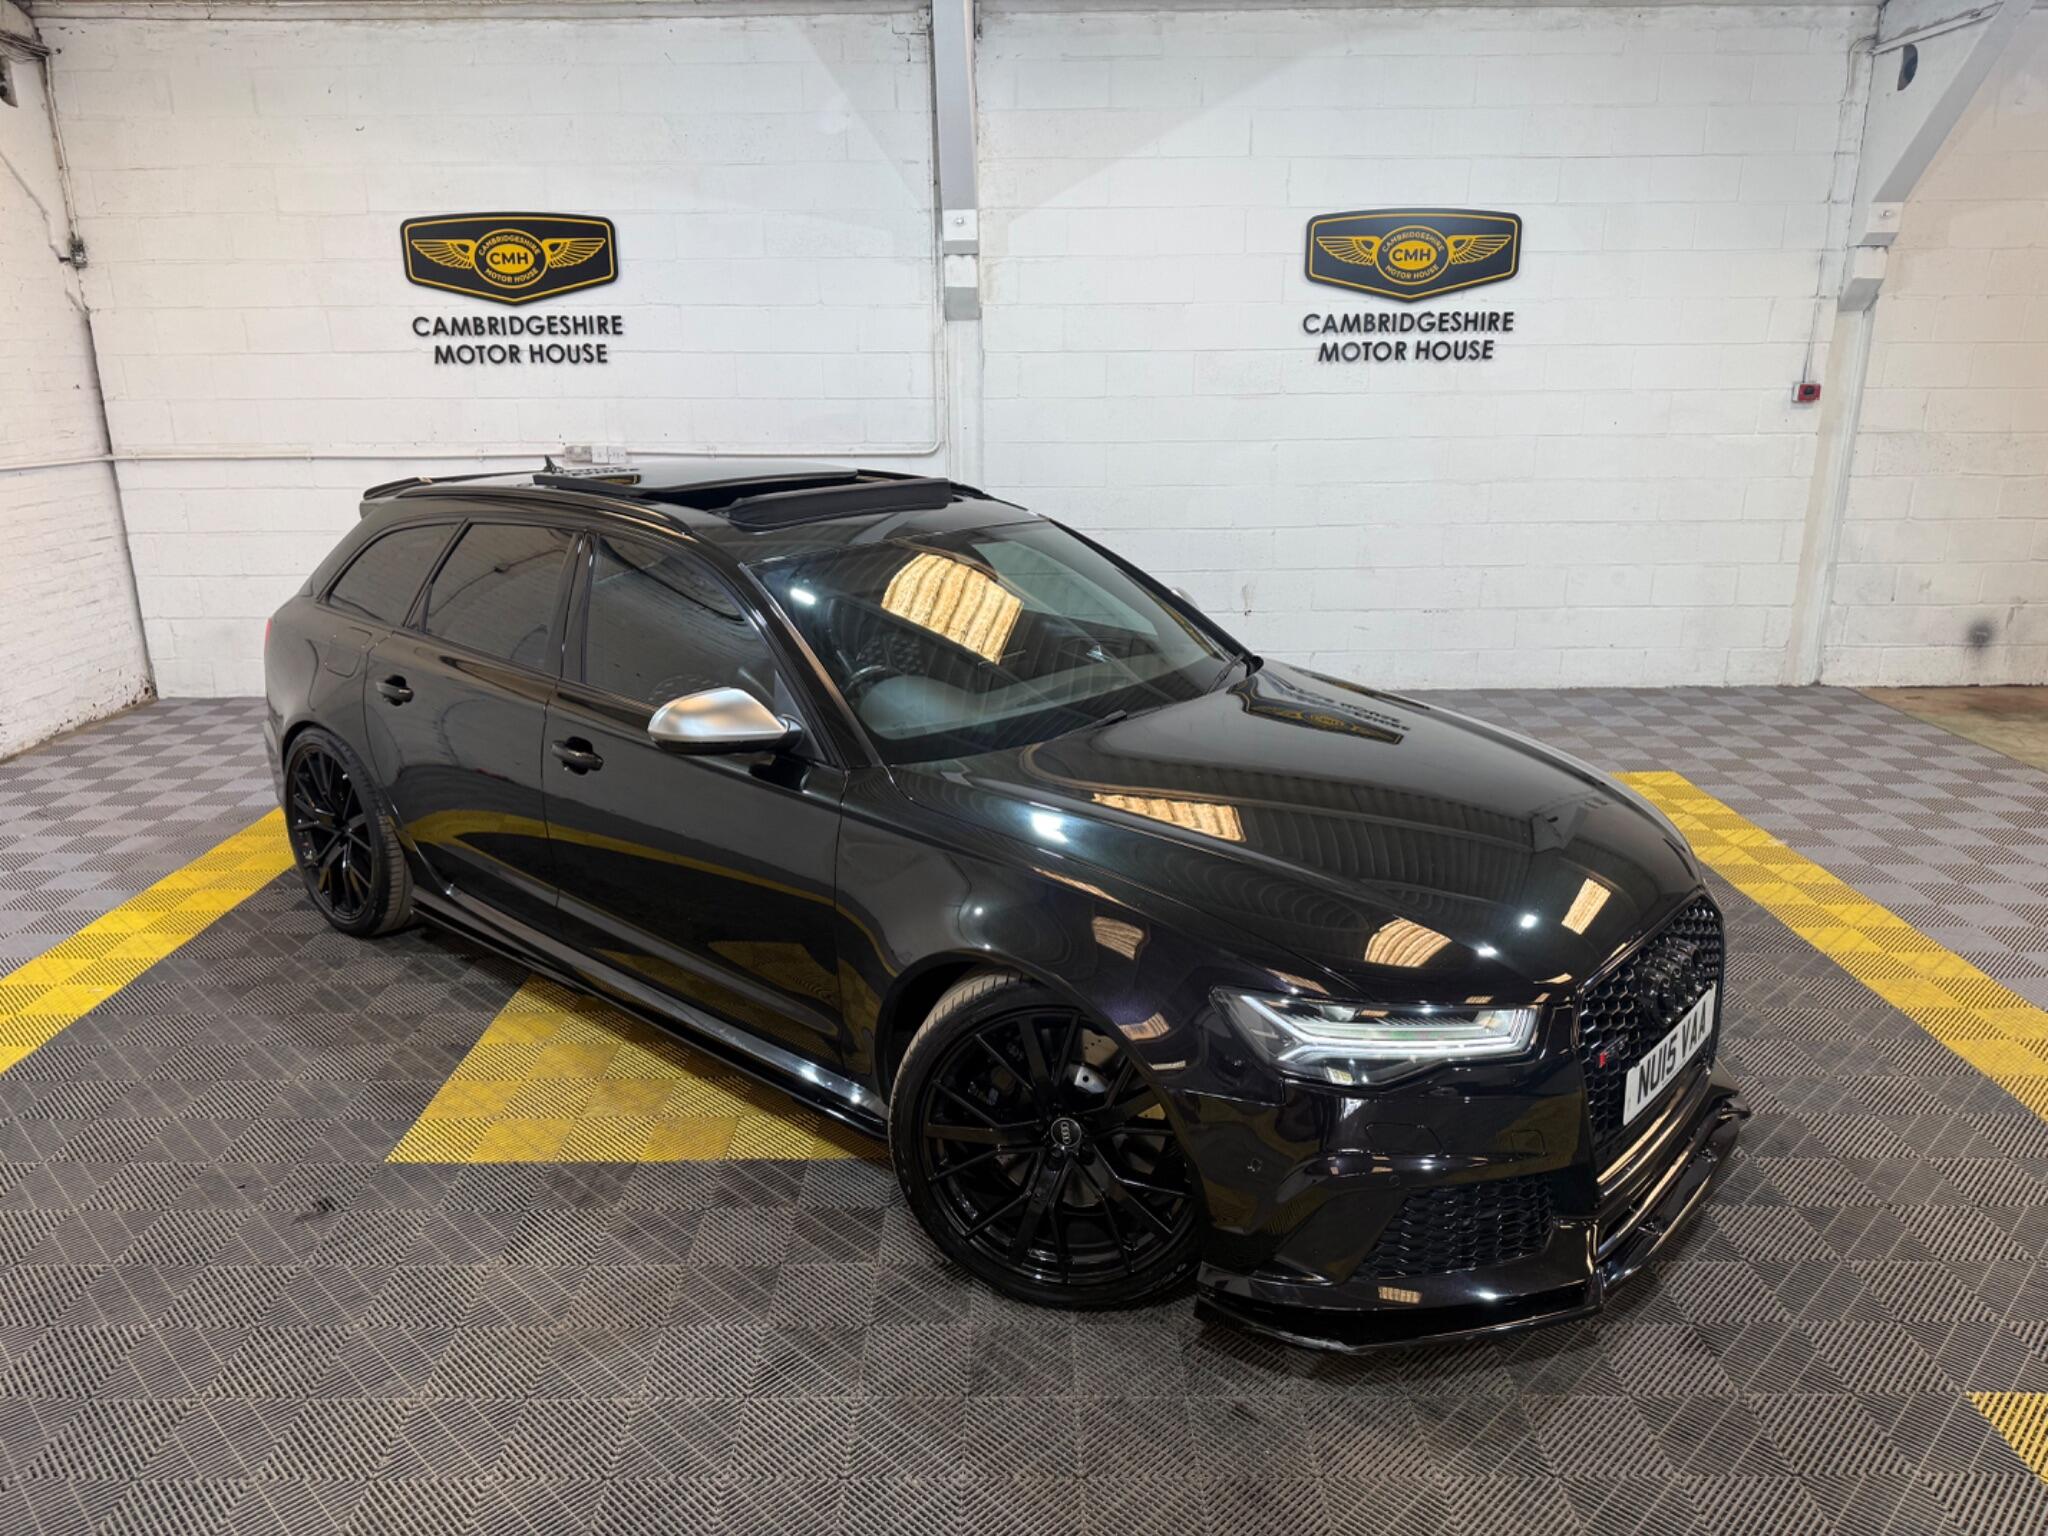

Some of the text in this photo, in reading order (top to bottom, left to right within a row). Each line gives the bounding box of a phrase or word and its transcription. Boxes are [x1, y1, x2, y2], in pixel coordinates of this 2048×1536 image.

[479, 235, 541, 256] CAMBRIDGESHIRE
[1381, 231, 1445, 253] CAMBRIDGESHIRE
[489, 252, 529, 265] CMH
[1391, 248, 1431, 262] CMH
[484, 268, 539, 283] MOTOR HOUSE
[1384, 264, 1440, 280] MOTOR HOUSE
[412, 315, 623, 337] CAMBRIDGESHIRE
[1302, 311, 1515, 335] CAMBRIDGESHIRE
[434, 343, 608, 365] MOTOR HOUSE
[1318, 339, 1495, 363] MOTOR HOUSE
[1637, 1032, 1678, 1104] NU15
[1682, 1001, 1706, 1058] VAA
